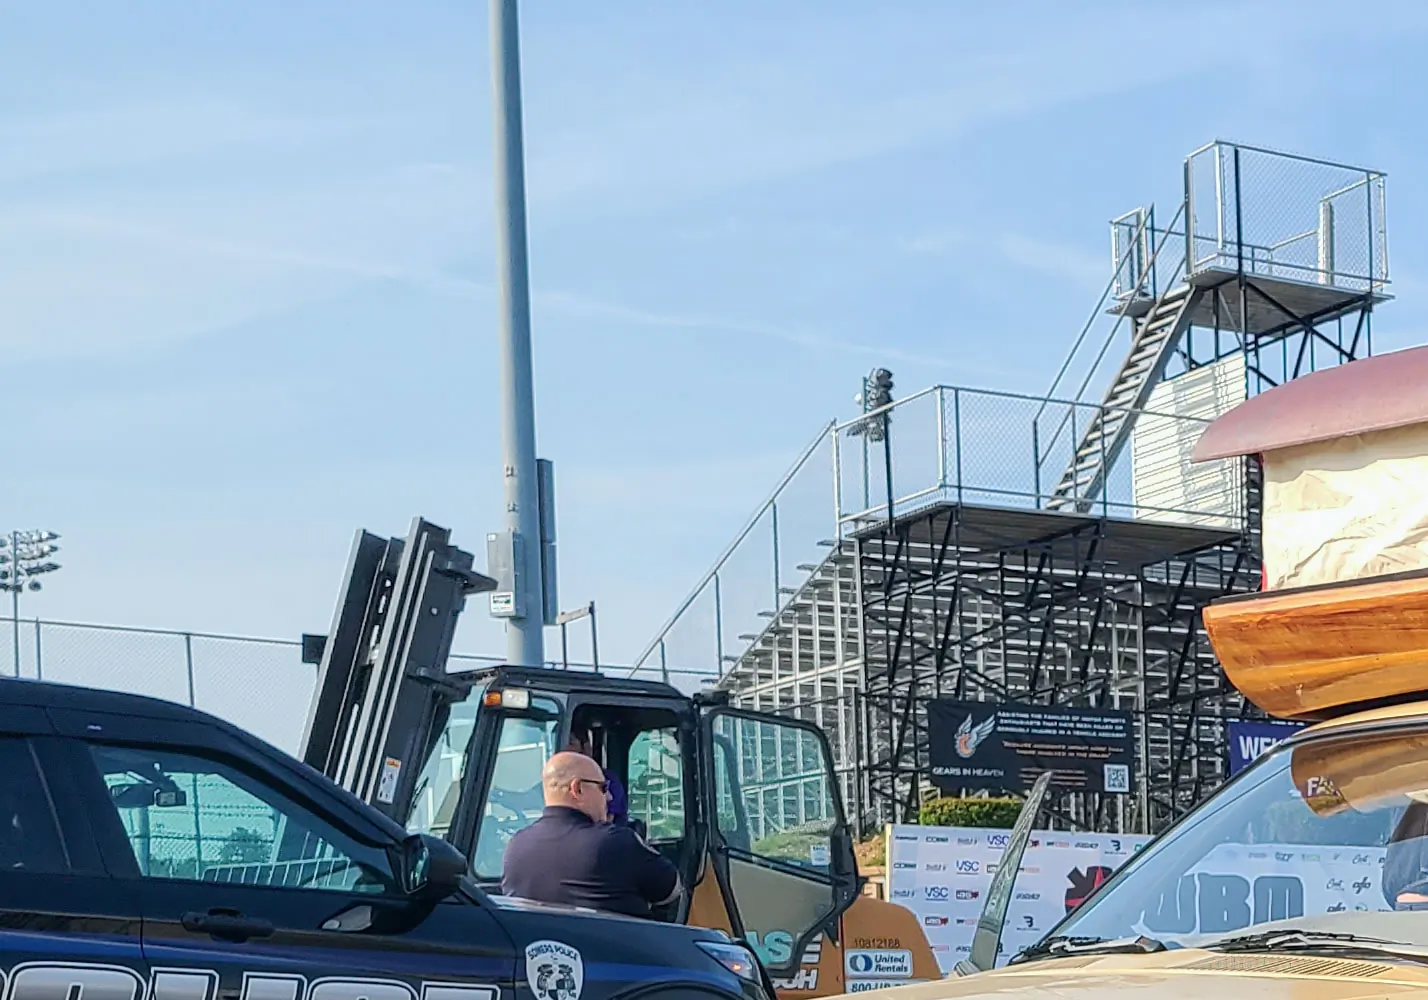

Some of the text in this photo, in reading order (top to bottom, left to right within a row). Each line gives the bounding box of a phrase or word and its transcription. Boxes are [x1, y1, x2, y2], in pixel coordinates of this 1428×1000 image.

[932, 766, 1004, 777] GEARS IN HEAVEN
[554, 944, 578, 962] POLICE
[875, 953, 905, 963] United
[875, 964, 908, 973] Rentals
